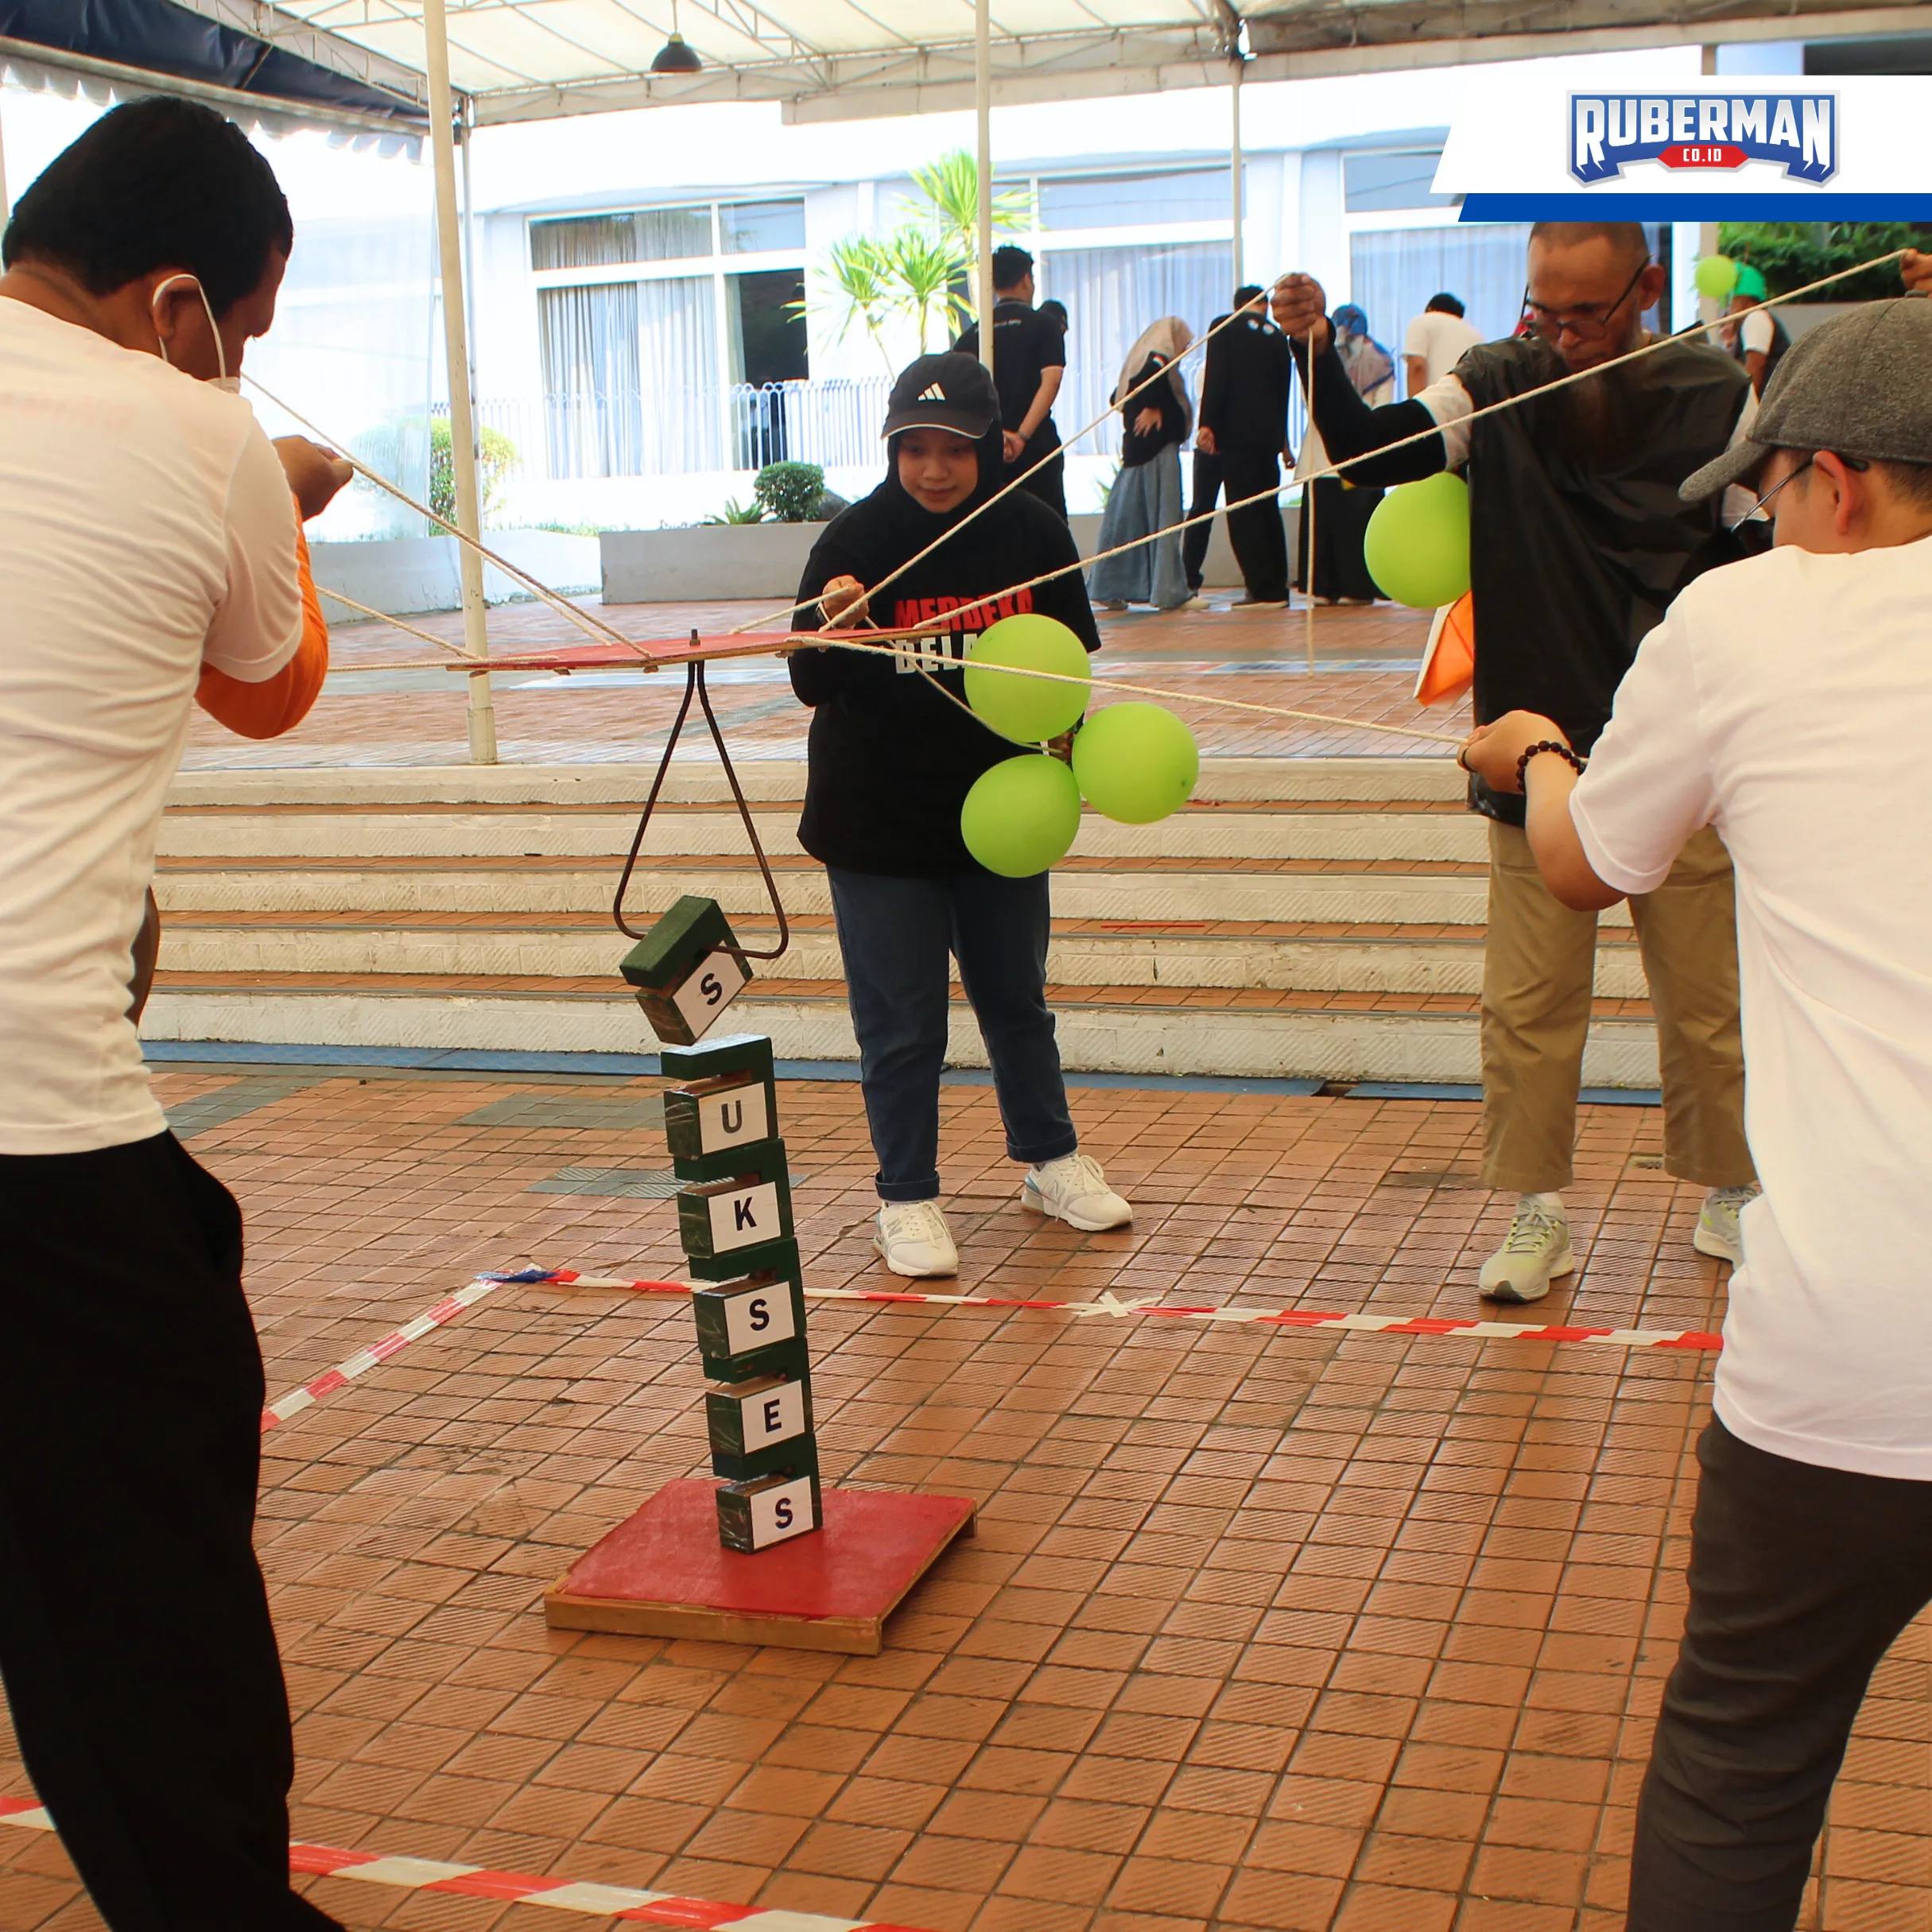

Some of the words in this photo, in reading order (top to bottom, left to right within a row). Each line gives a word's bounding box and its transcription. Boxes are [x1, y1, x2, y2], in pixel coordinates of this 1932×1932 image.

[894, 588, 1033, 630] MERDEKA
[700, 972, 723, 1006] S
[720, 1100, 743, 1133] U
[734, 1197, 757, 1232] K
[749, 1298, 770, 1331] S
[763, 1399, 782, 1433] E
[774, 1497, 793, 1529] S
